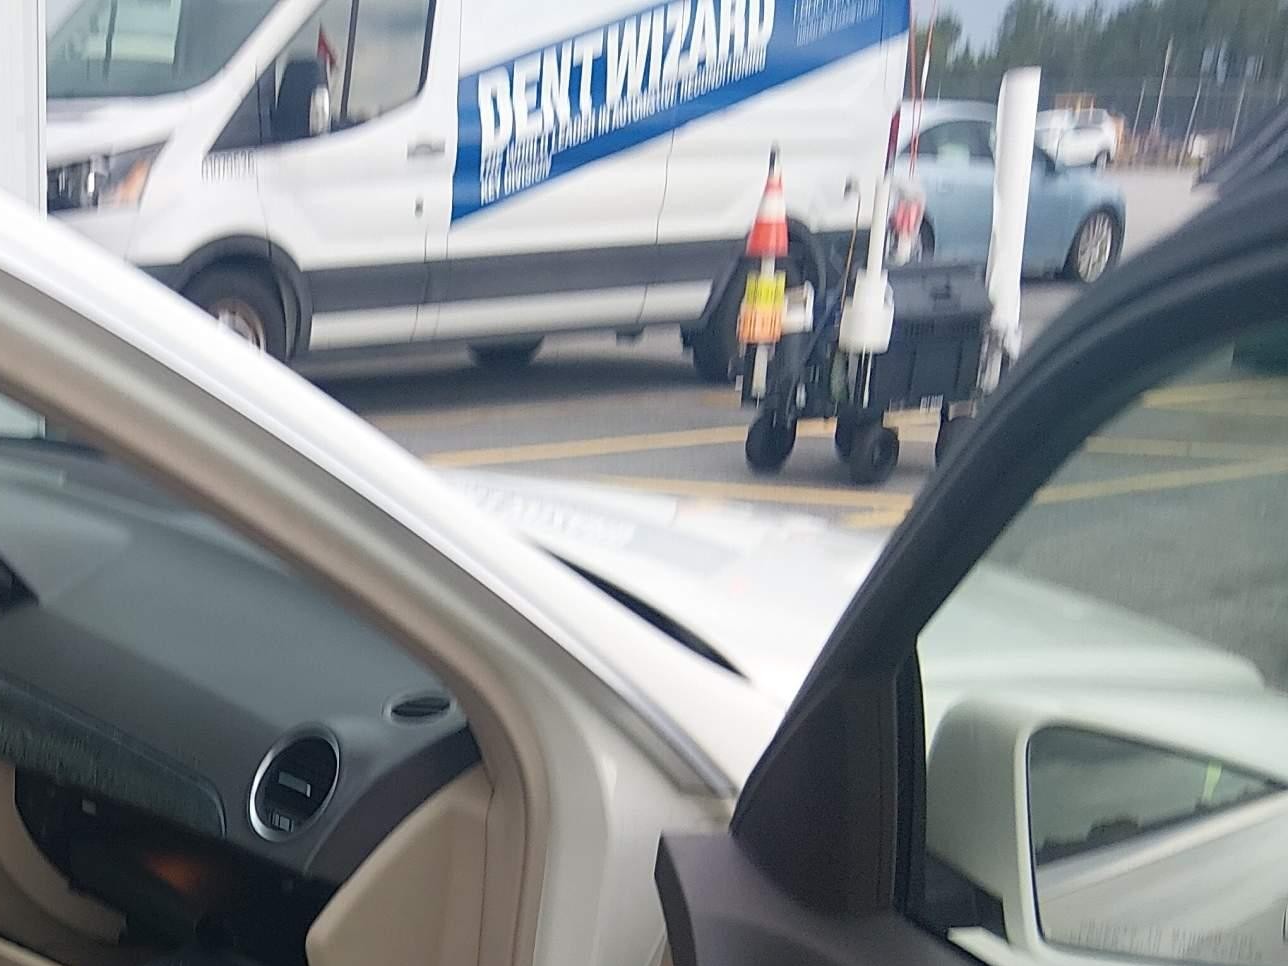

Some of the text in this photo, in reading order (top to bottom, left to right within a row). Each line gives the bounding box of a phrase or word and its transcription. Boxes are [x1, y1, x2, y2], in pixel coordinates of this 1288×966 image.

[477, 0, 775, 157] DENT WIZARD
[551, 109, 596, 155] LEADER
[480, 151, 552, 206] KEY DIVISION
